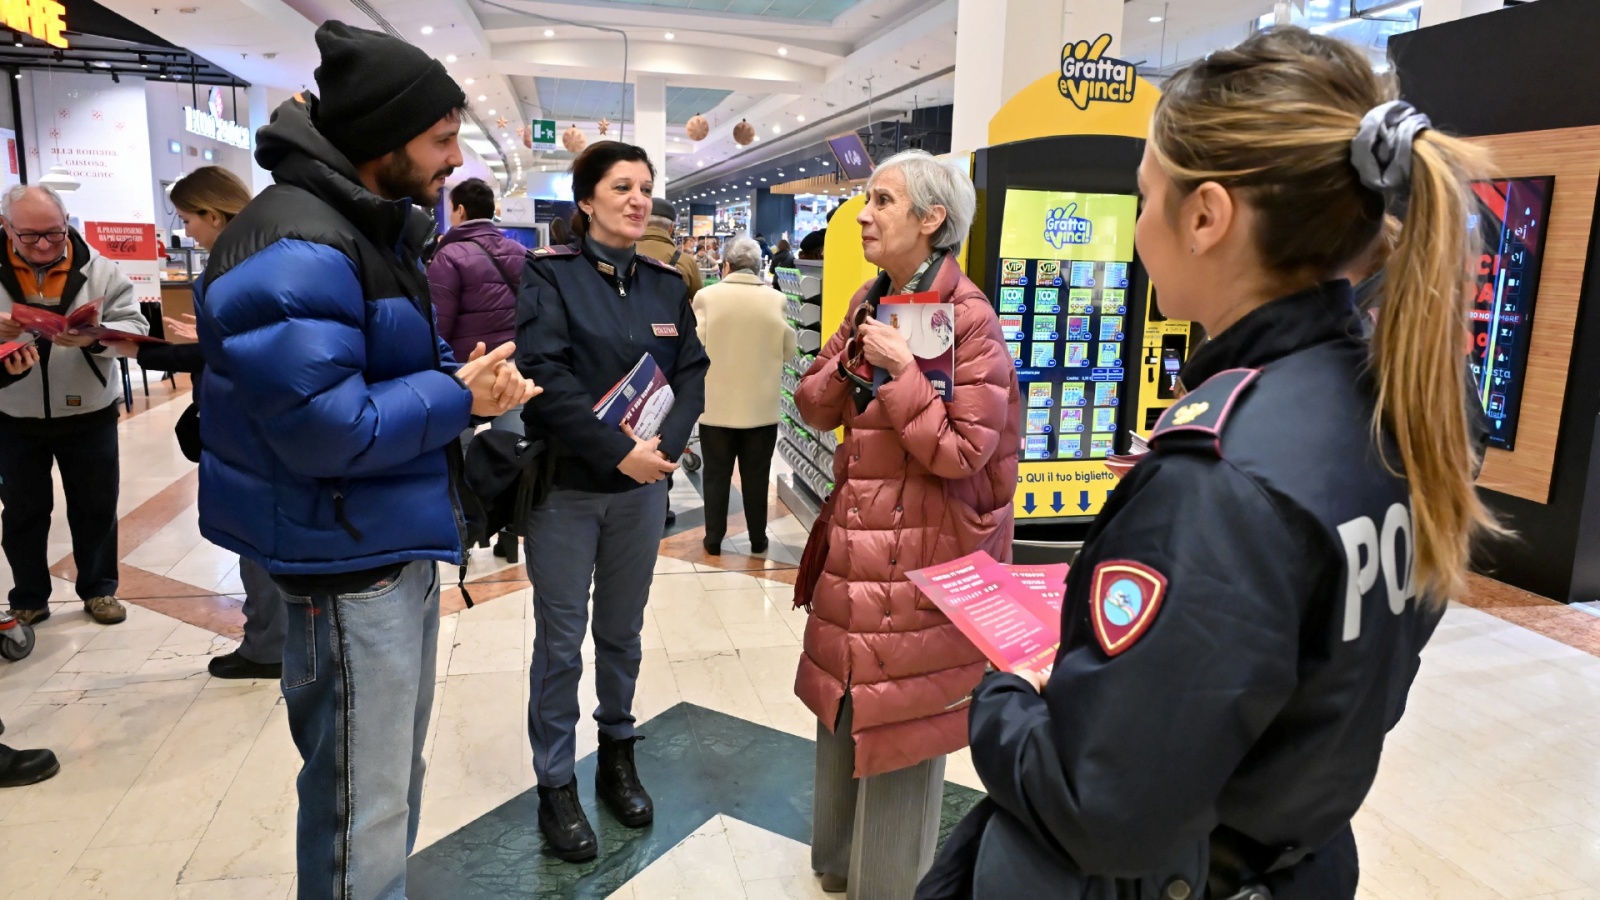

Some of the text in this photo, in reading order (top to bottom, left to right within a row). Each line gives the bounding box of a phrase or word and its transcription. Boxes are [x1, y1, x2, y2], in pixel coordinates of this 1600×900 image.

[1063, 57, 1126, 81] Gratta
[1060, 79, 1067, 94] e
[1047, 217, 1086, 231] Gratta
[1026, 473, 1044, 483] QUI
[1047, 472, 1053, 481] il
[1056, 473, 1072, 482] tuo
[1075, 470, 1114, 483] biglietto
